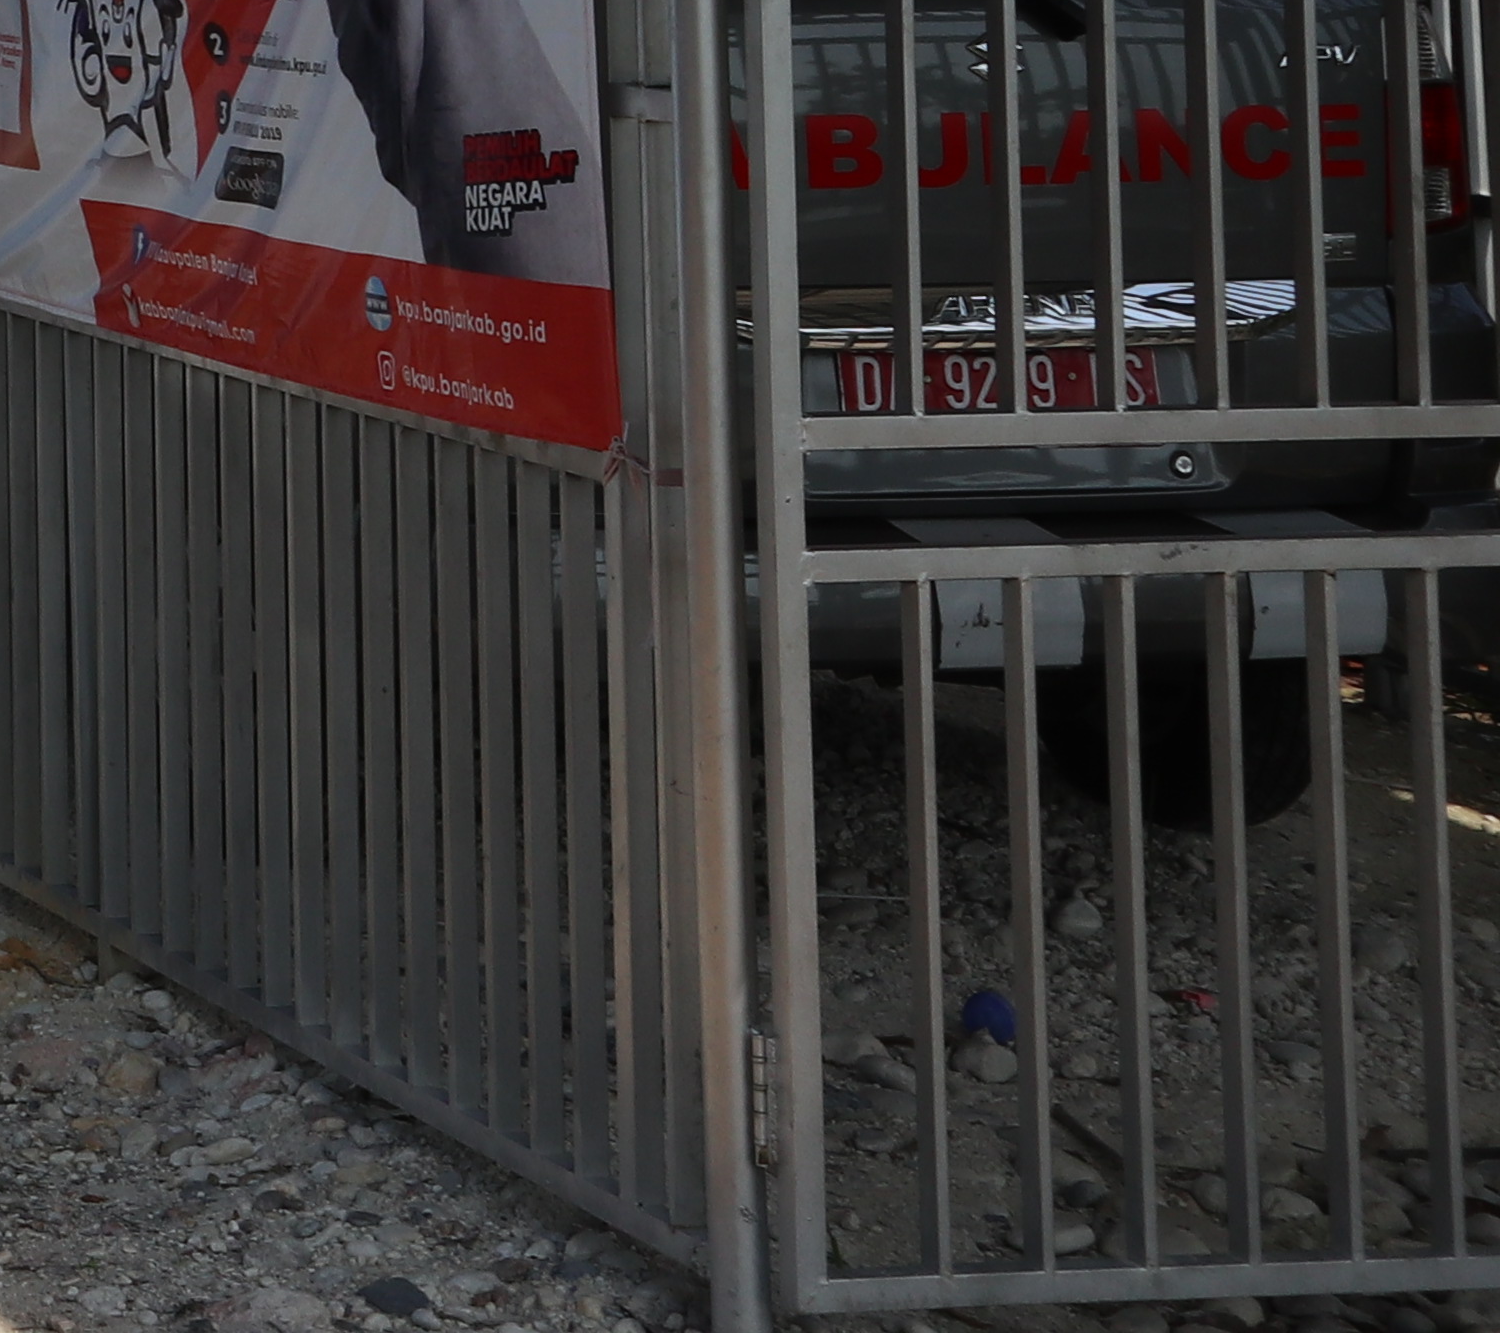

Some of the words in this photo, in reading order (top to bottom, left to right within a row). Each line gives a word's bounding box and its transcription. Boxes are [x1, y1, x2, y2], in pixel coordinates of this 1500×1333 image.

[464, 181, 544, 209] NEGARA
[466, 207, 512, 233] KUAT
[396, 295, 547, 345] kpu.banjarkab.go.id
[402, 364, 514, 410] @kpu.banjarkab
[943, 352, 1056, 410] 929
